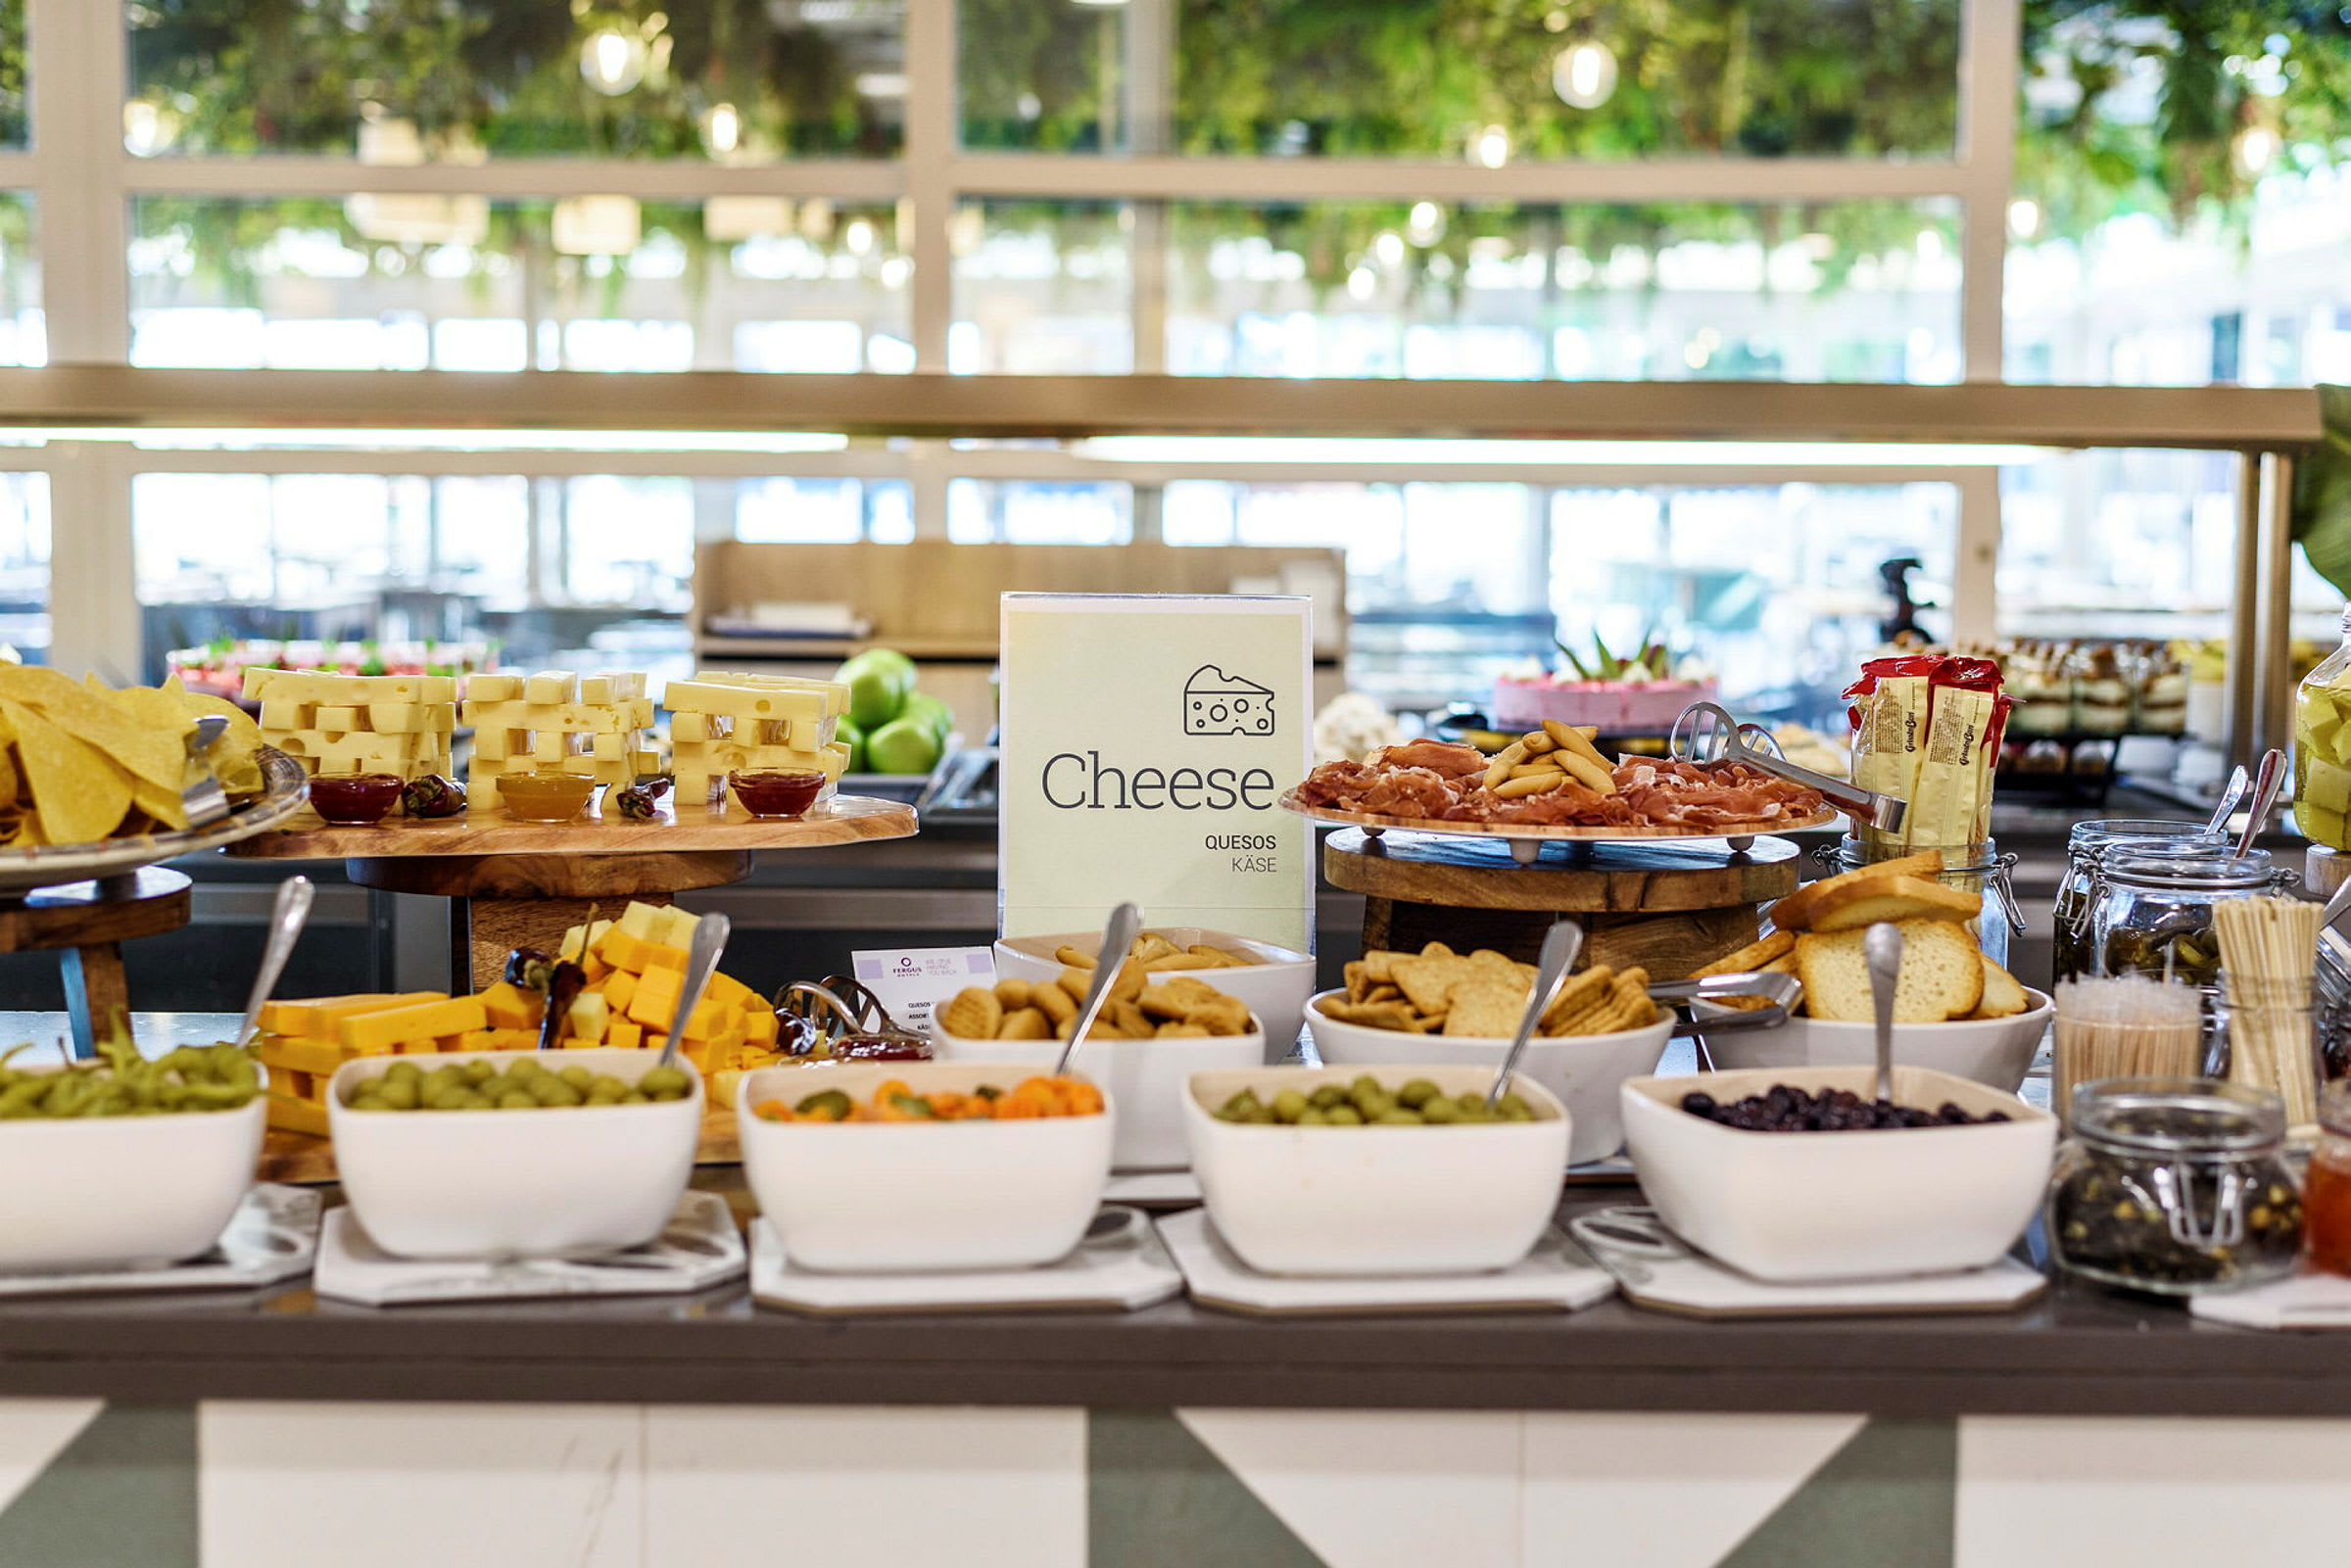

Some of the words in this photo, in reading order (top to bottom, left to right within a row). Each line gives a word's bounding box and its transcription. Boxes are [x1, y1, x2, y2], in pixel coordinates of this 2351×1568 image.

[1041, 750, 1274, 811] Cheese
[1205, 834, 1276, 851] QUESOS
[1231, 855, 1277, 873] KÄSE
